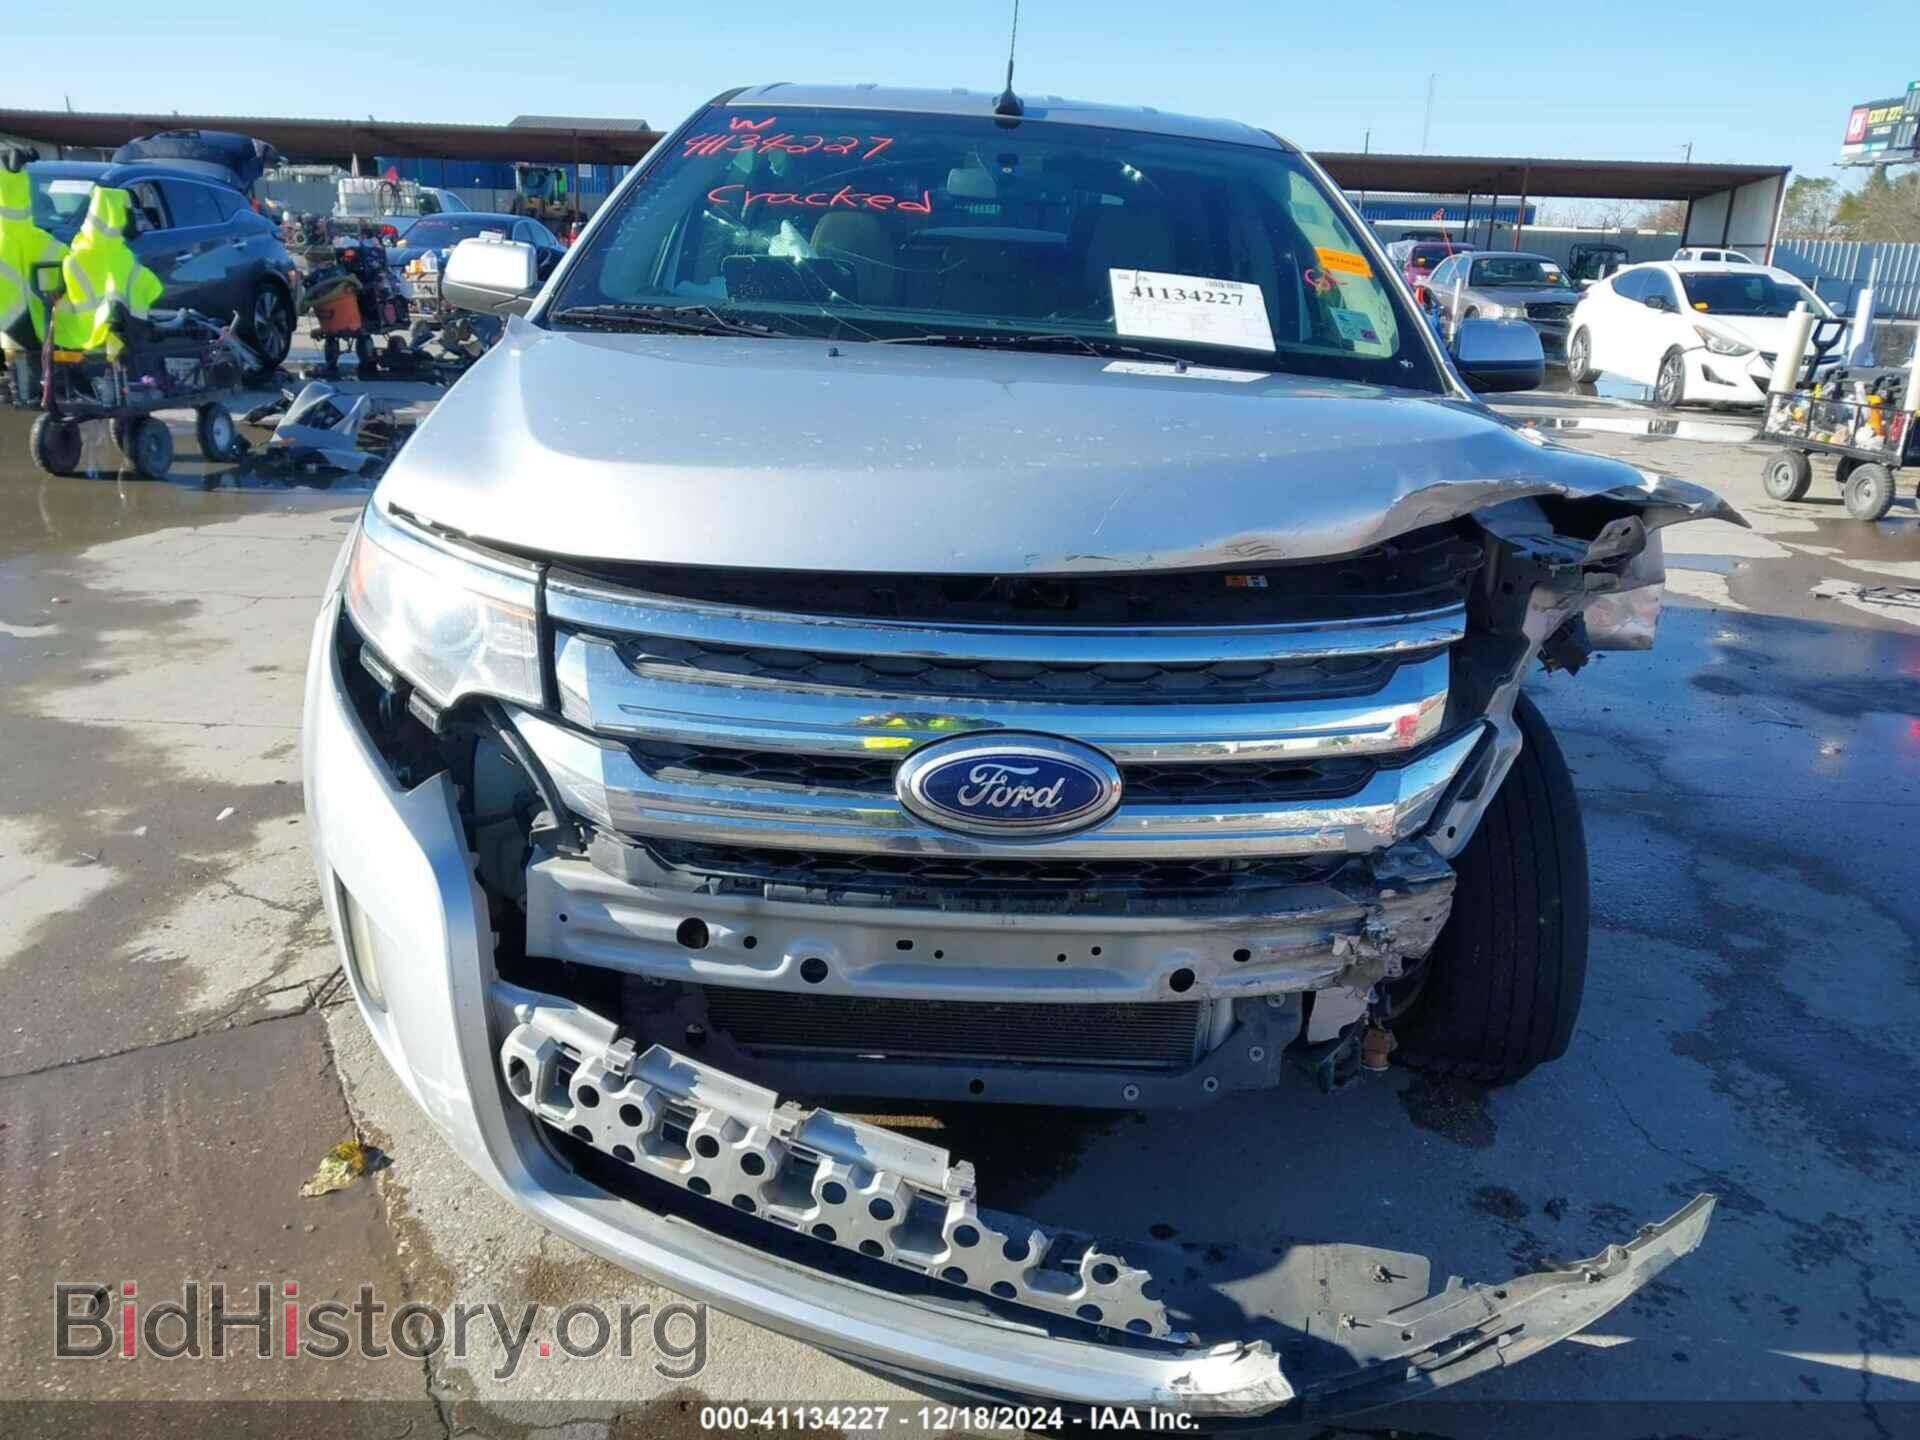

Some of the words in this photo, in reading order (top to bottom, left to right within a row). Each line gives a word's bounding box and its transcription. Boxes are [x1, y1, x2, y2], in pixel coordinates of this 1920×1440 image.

[707, 184, 932, 213] Cracked
[1129, 284, 1244, 307] 41134227
[957, 763, 1066, 809] Ford
